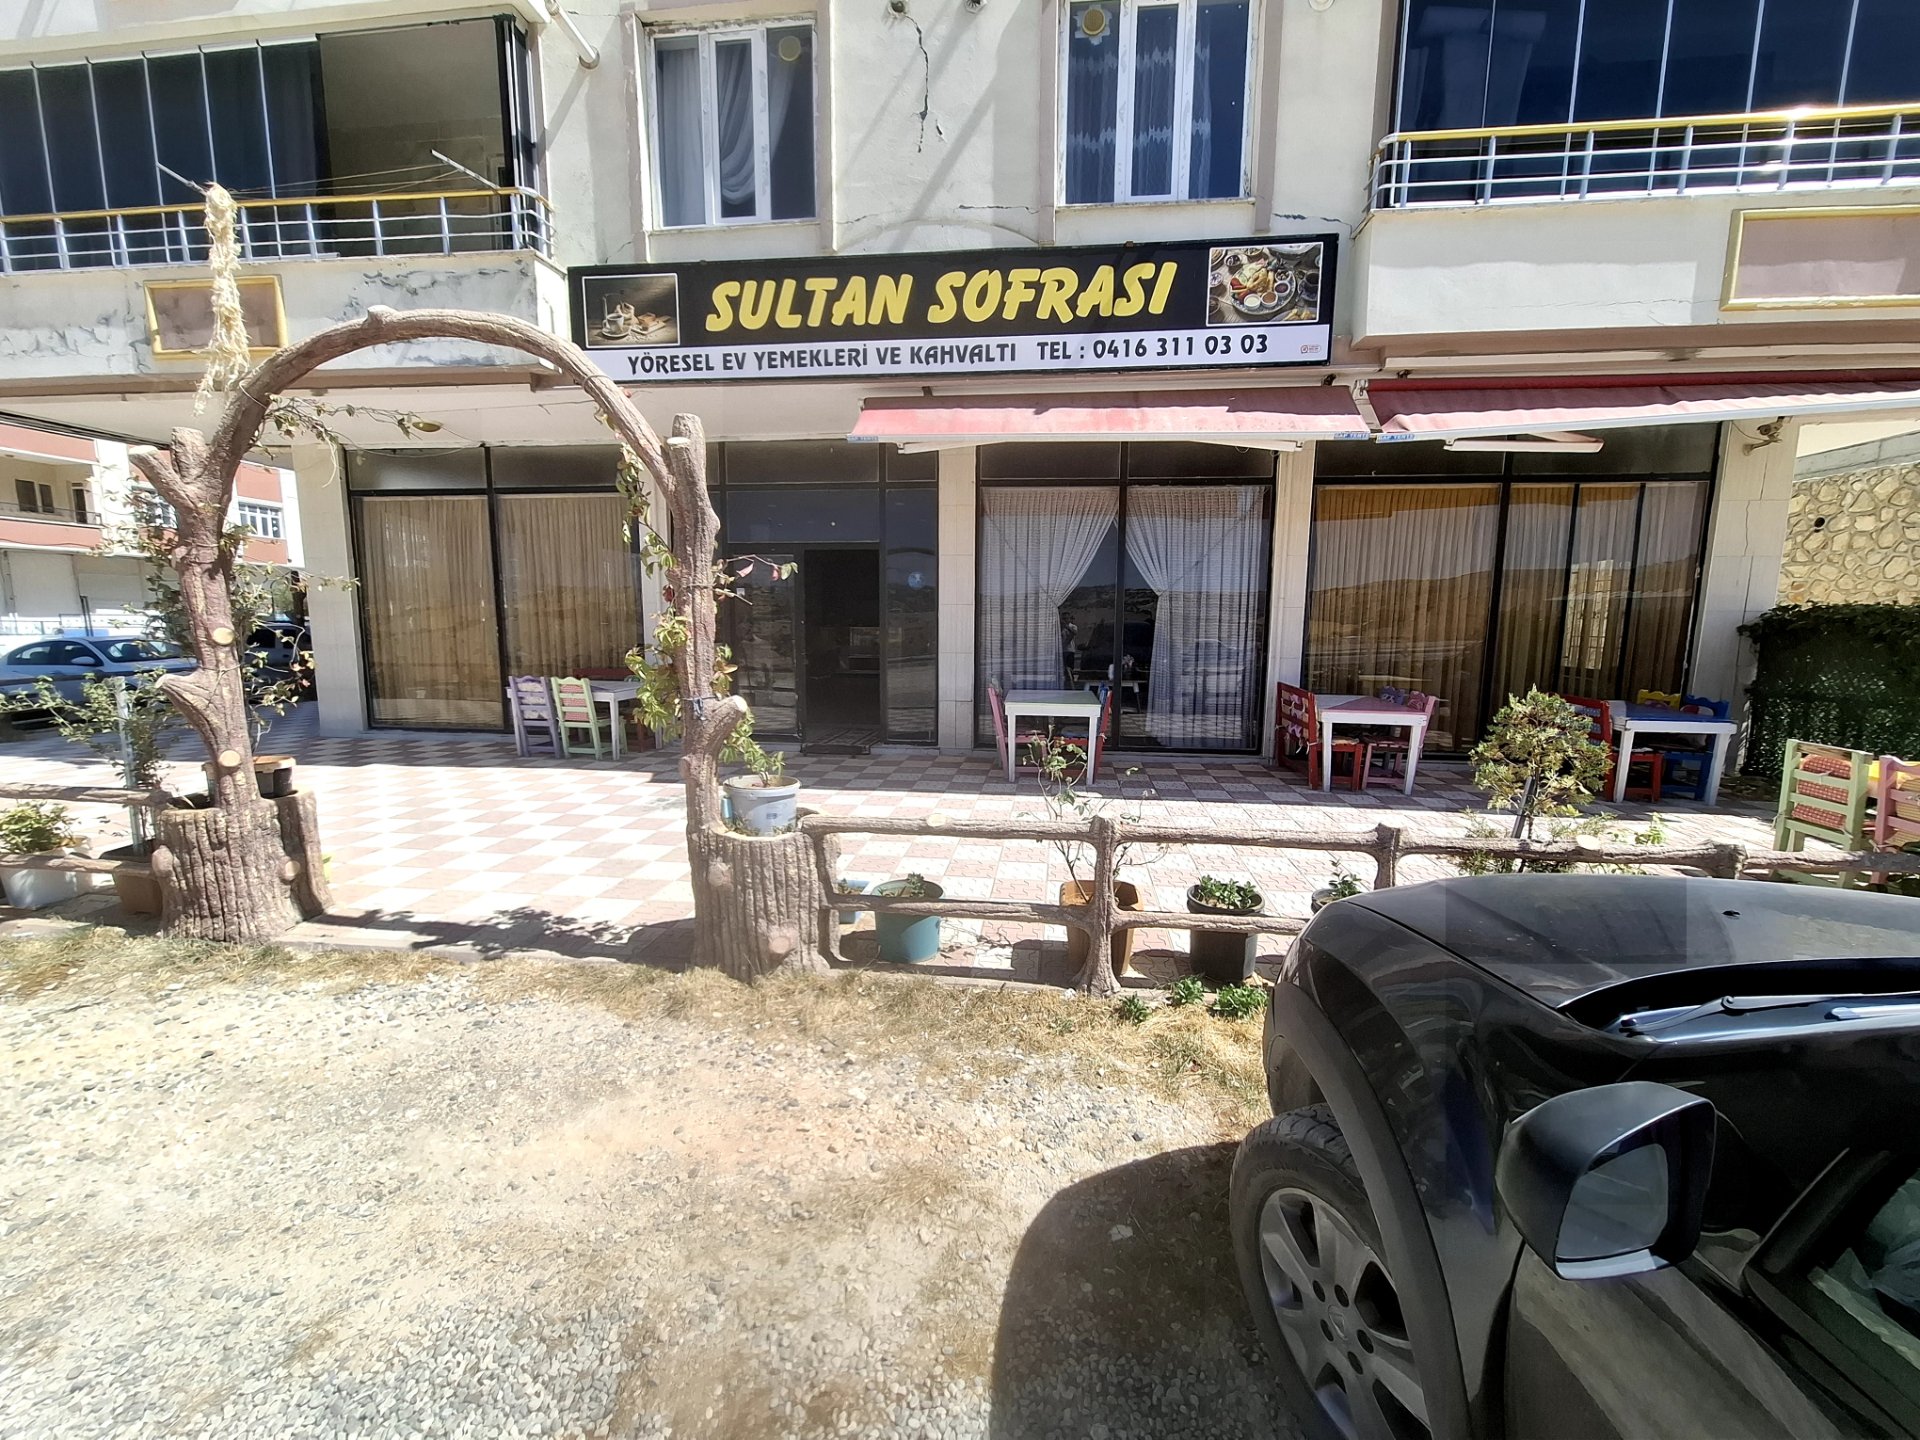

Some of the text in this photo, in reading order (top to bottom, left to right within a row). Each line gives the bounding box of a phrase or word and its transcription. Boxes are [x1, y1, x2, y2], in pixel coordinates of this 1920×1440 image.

[705, 262, 1178, 332] SULTAN SOFRASI
[628, 351, 715, 375] YÖRESEL
[722, 352, 747, 371] EV
[754, 344, 868, 371] YEMEKLERİ
[876, 346, 902, 365] VE
[910, 343, 1016, 366] KAHVALTI
[1037, 341, 1072, 360] TEL
[1093, 338, 1148, 359] 0416
[1156, 336, 1194, 357] 311
[1205, 335, 1232, 355] 03
[1240, 334, 1268, 354] 03
